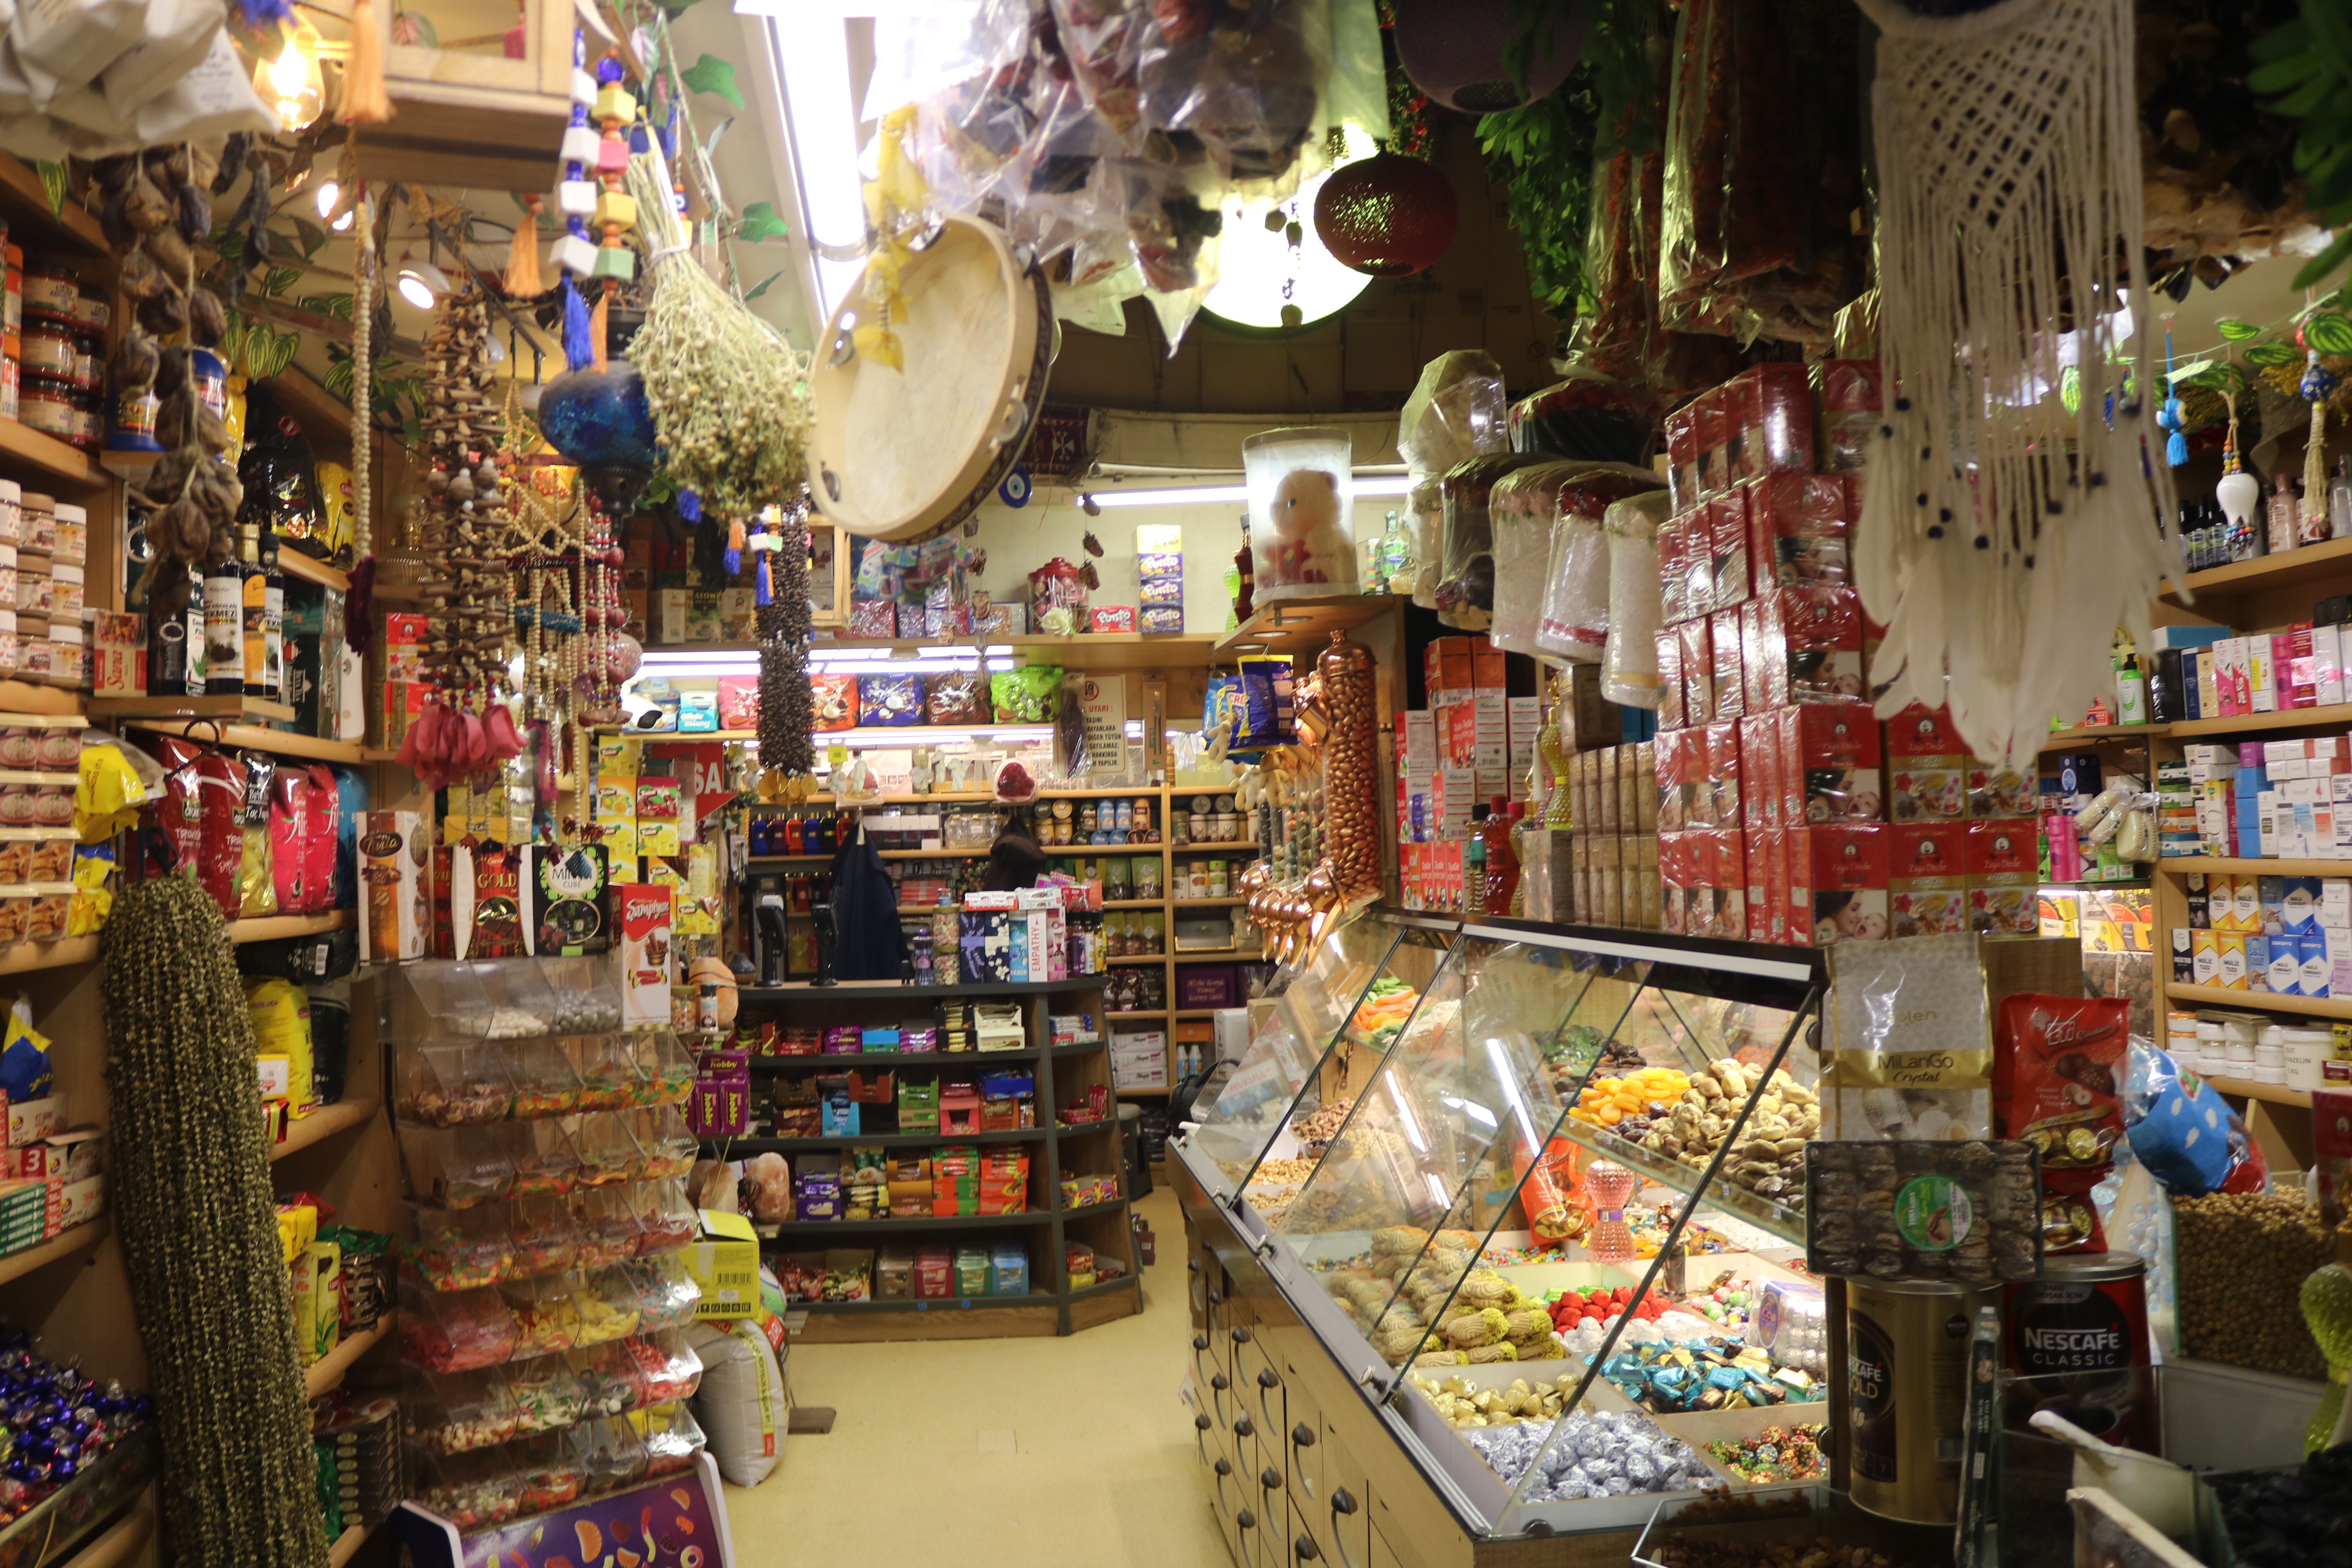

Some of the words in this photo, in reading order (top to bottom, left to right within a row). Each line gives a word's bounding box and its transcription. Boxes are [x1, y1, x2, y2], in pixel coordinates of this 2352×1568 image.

[1146, 554, 1179, 568] Punto
[1146, 581, 1178, 595] Punto
[1096, 610, 1132, 623] Punto
[1148, 608, 1181, 622] Punto
[107, 650, 125, 690] Sana
[1089, 704, 1109, 713] UYARI
[477, 873, 517, 889] GOLD
[1032, 926, 1041, 972] EMPATHY
[709, 1060, 737, 1069] hobby
[1893, 1071, 1940, 1085] Crystal
[704, 1093, 712, 1127] hobby
[728, 1093, 737, 1127] hobby
[25, 1149, 41, 1172] 3
[2033, 1353, 2115, 1366] CLASSIC
[1851, 1375, 1878, 1399] OLD
